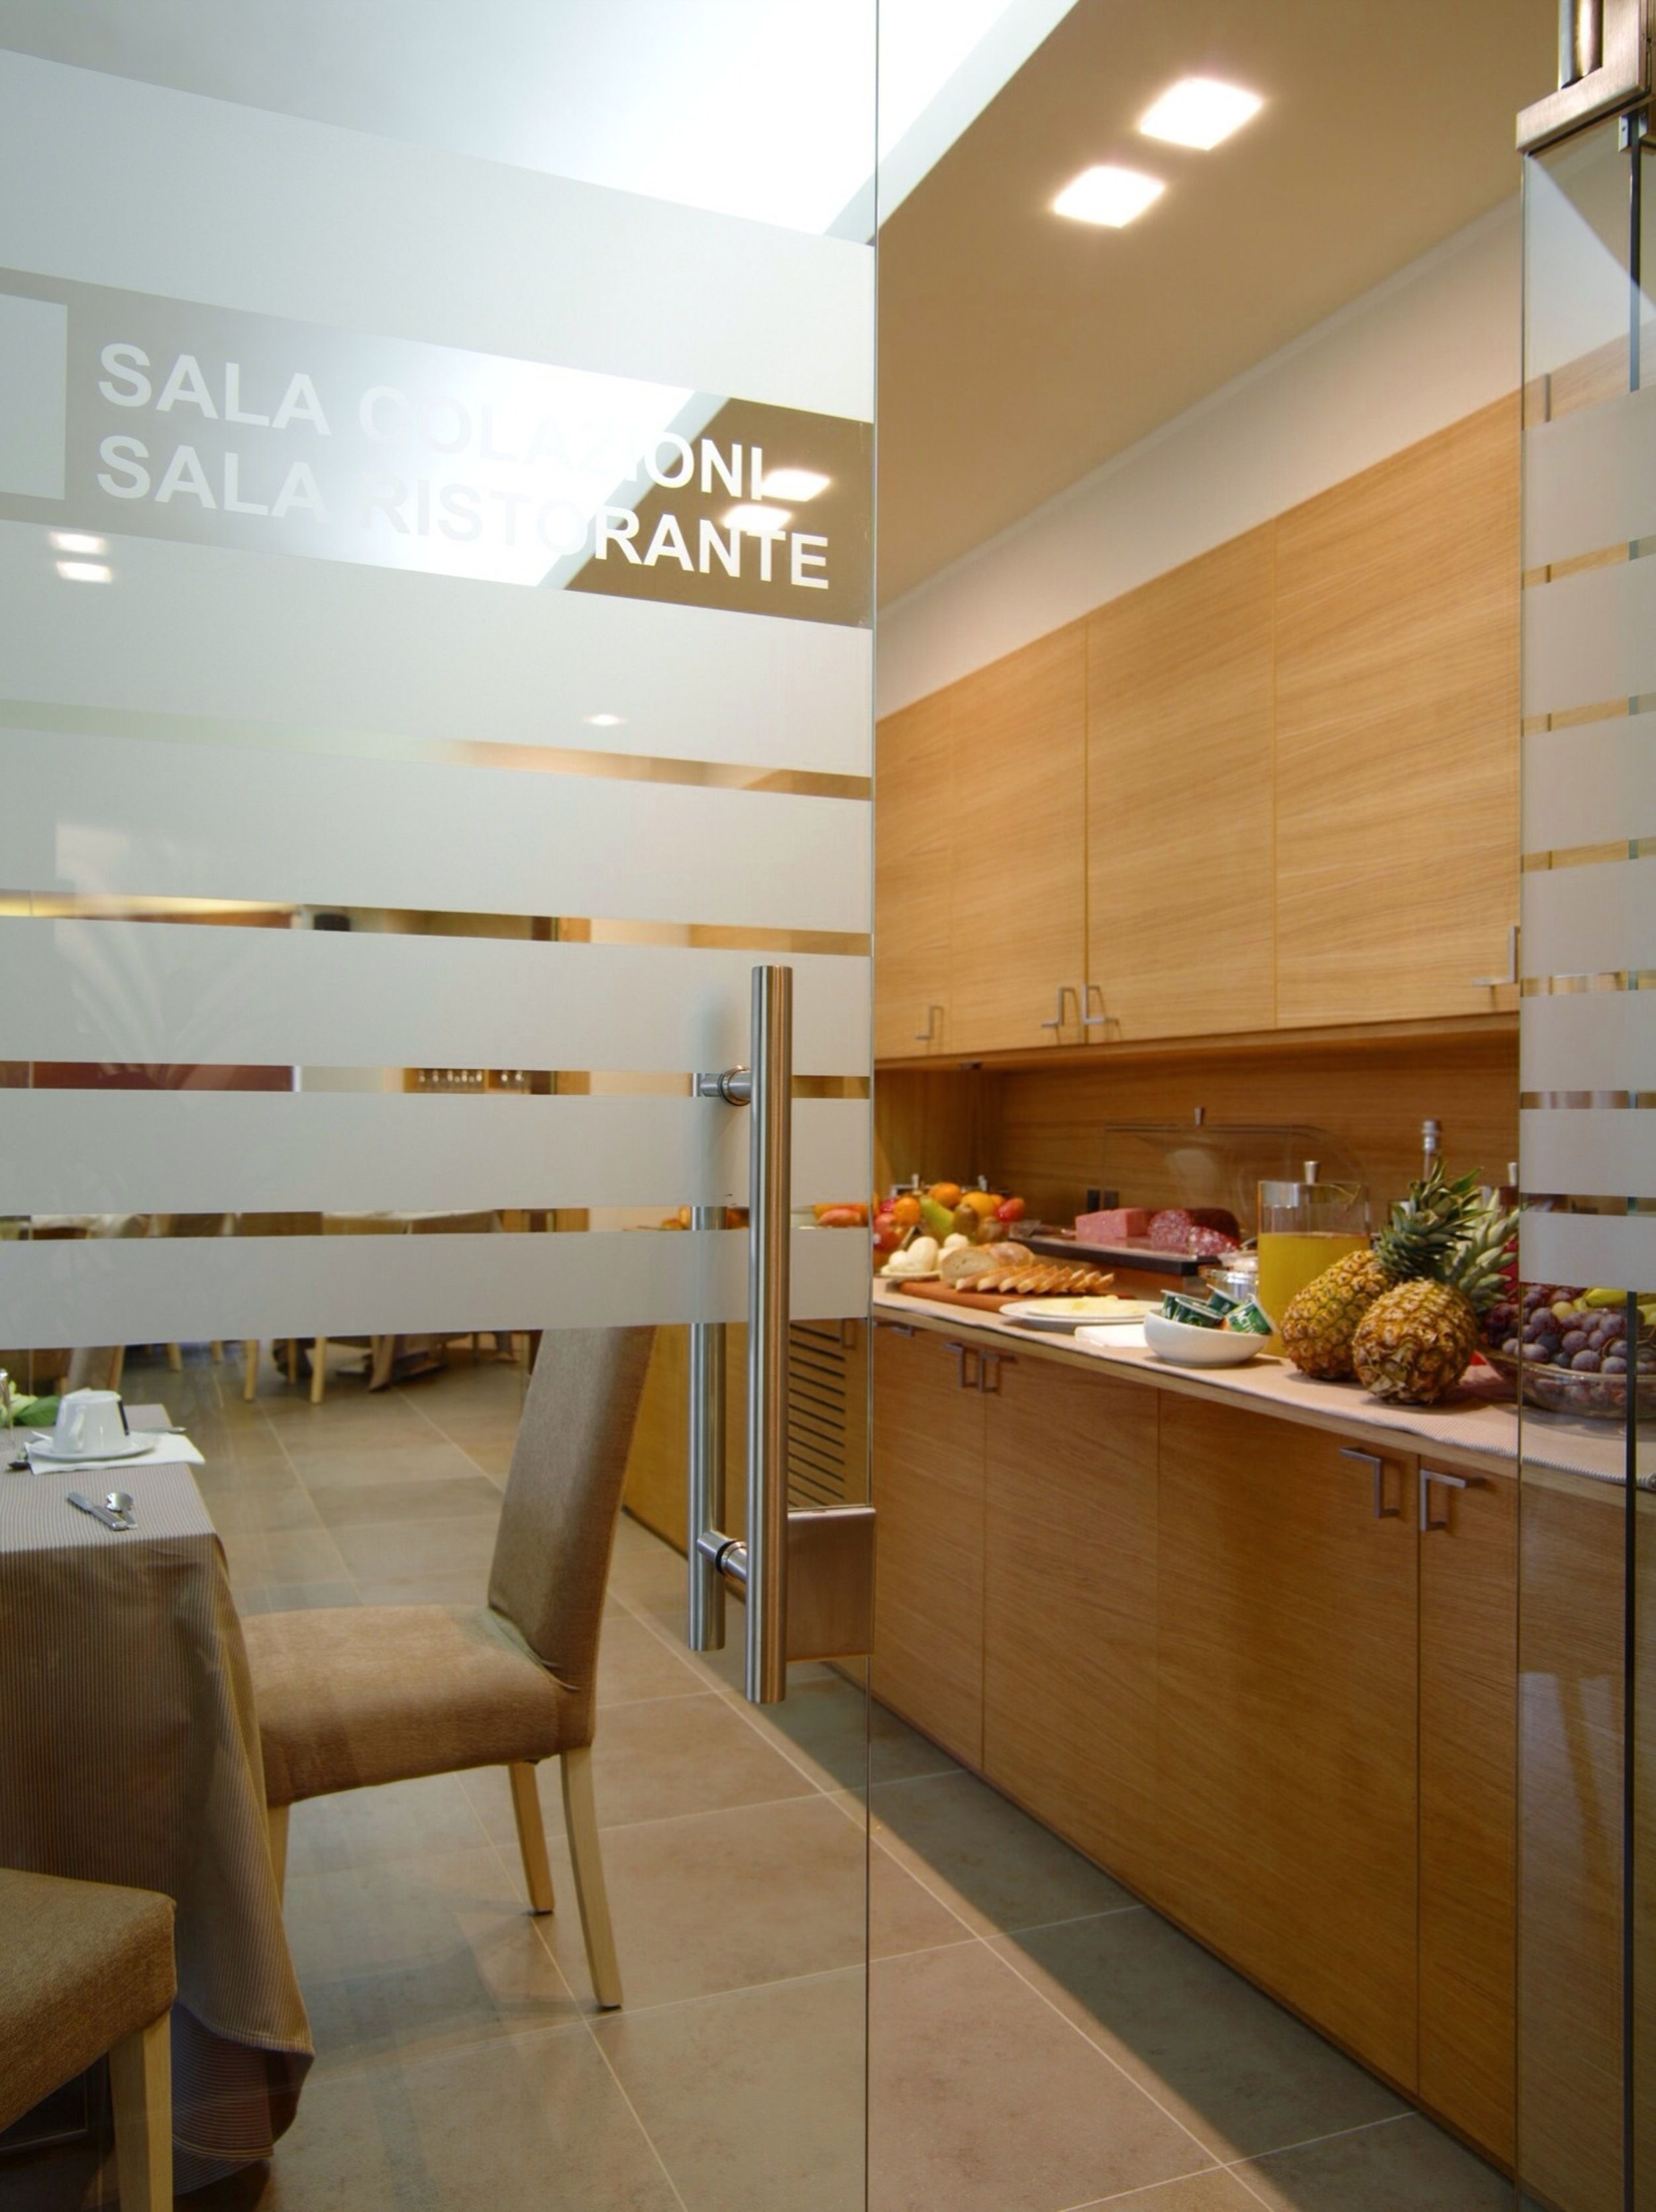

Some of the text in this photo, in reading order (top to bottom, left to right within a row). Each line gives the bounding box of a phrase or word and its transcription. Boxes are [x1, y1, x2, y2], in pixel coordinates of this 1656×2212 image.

[99, 343, 332, 436] SALA
[97, 435, 829, 589] SALA RISTORANTE
